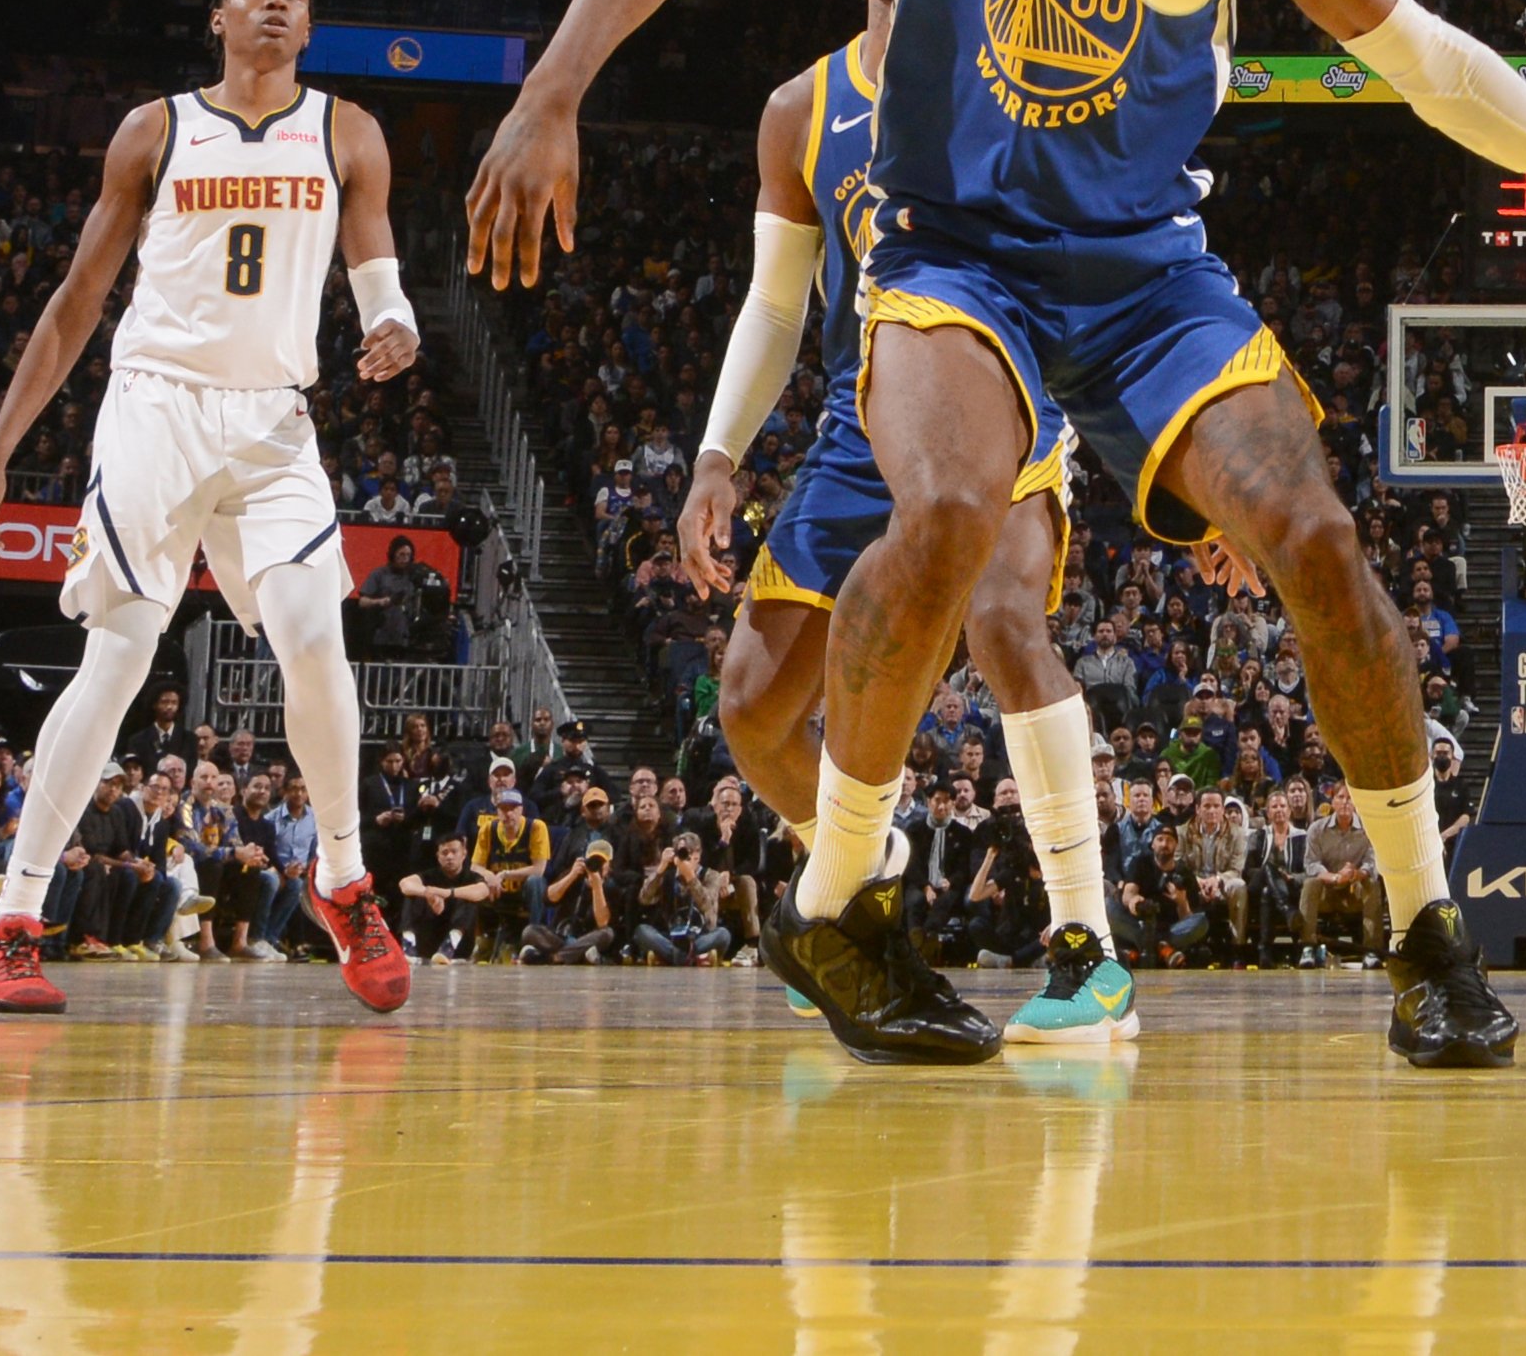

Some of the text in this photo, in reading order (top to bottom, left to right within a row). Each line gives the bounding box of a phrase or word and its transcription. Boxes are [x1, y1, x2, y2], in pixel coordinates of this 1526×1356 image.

[975, 44, 1127, 128] WARRIORS
[1229, 67, 1273, 90] Starry
[1322, 64, 1368, 91] Starry
[277, 130, 317, 144] ibotta
[172, 175, 325, 213] NUGGETS
[225, 224, 266, 297] 8
